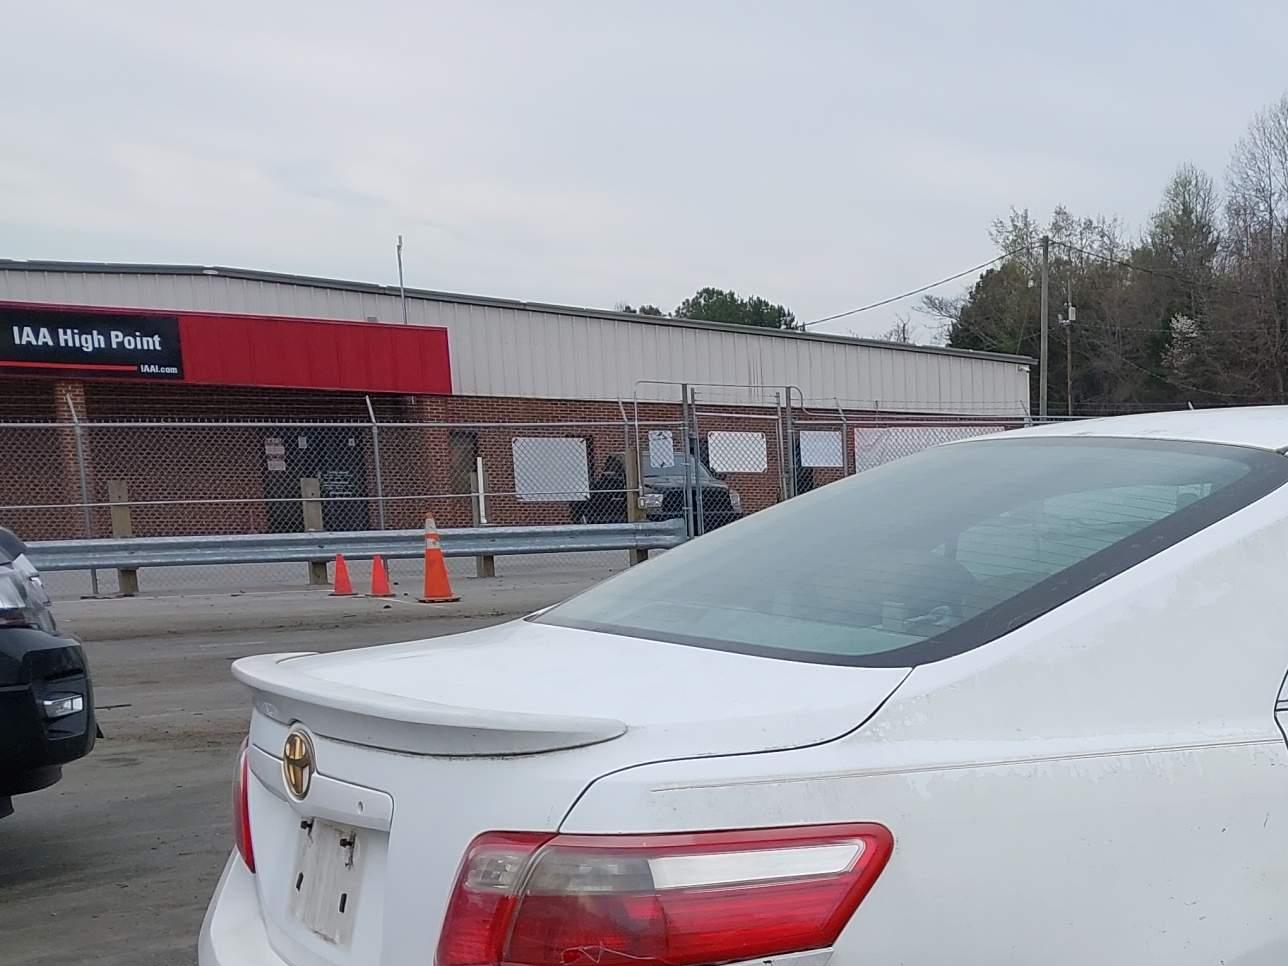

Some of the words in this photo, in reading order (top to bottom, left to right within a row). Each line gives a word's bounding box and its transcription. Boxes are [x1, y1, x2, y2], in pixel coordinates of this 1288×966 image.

[12, 326, 54, 346] IAA
[58, 328, 105, 352] High
[110, 330, 162, 350] Point
[140, 364, 178, 374] IAAI.com
